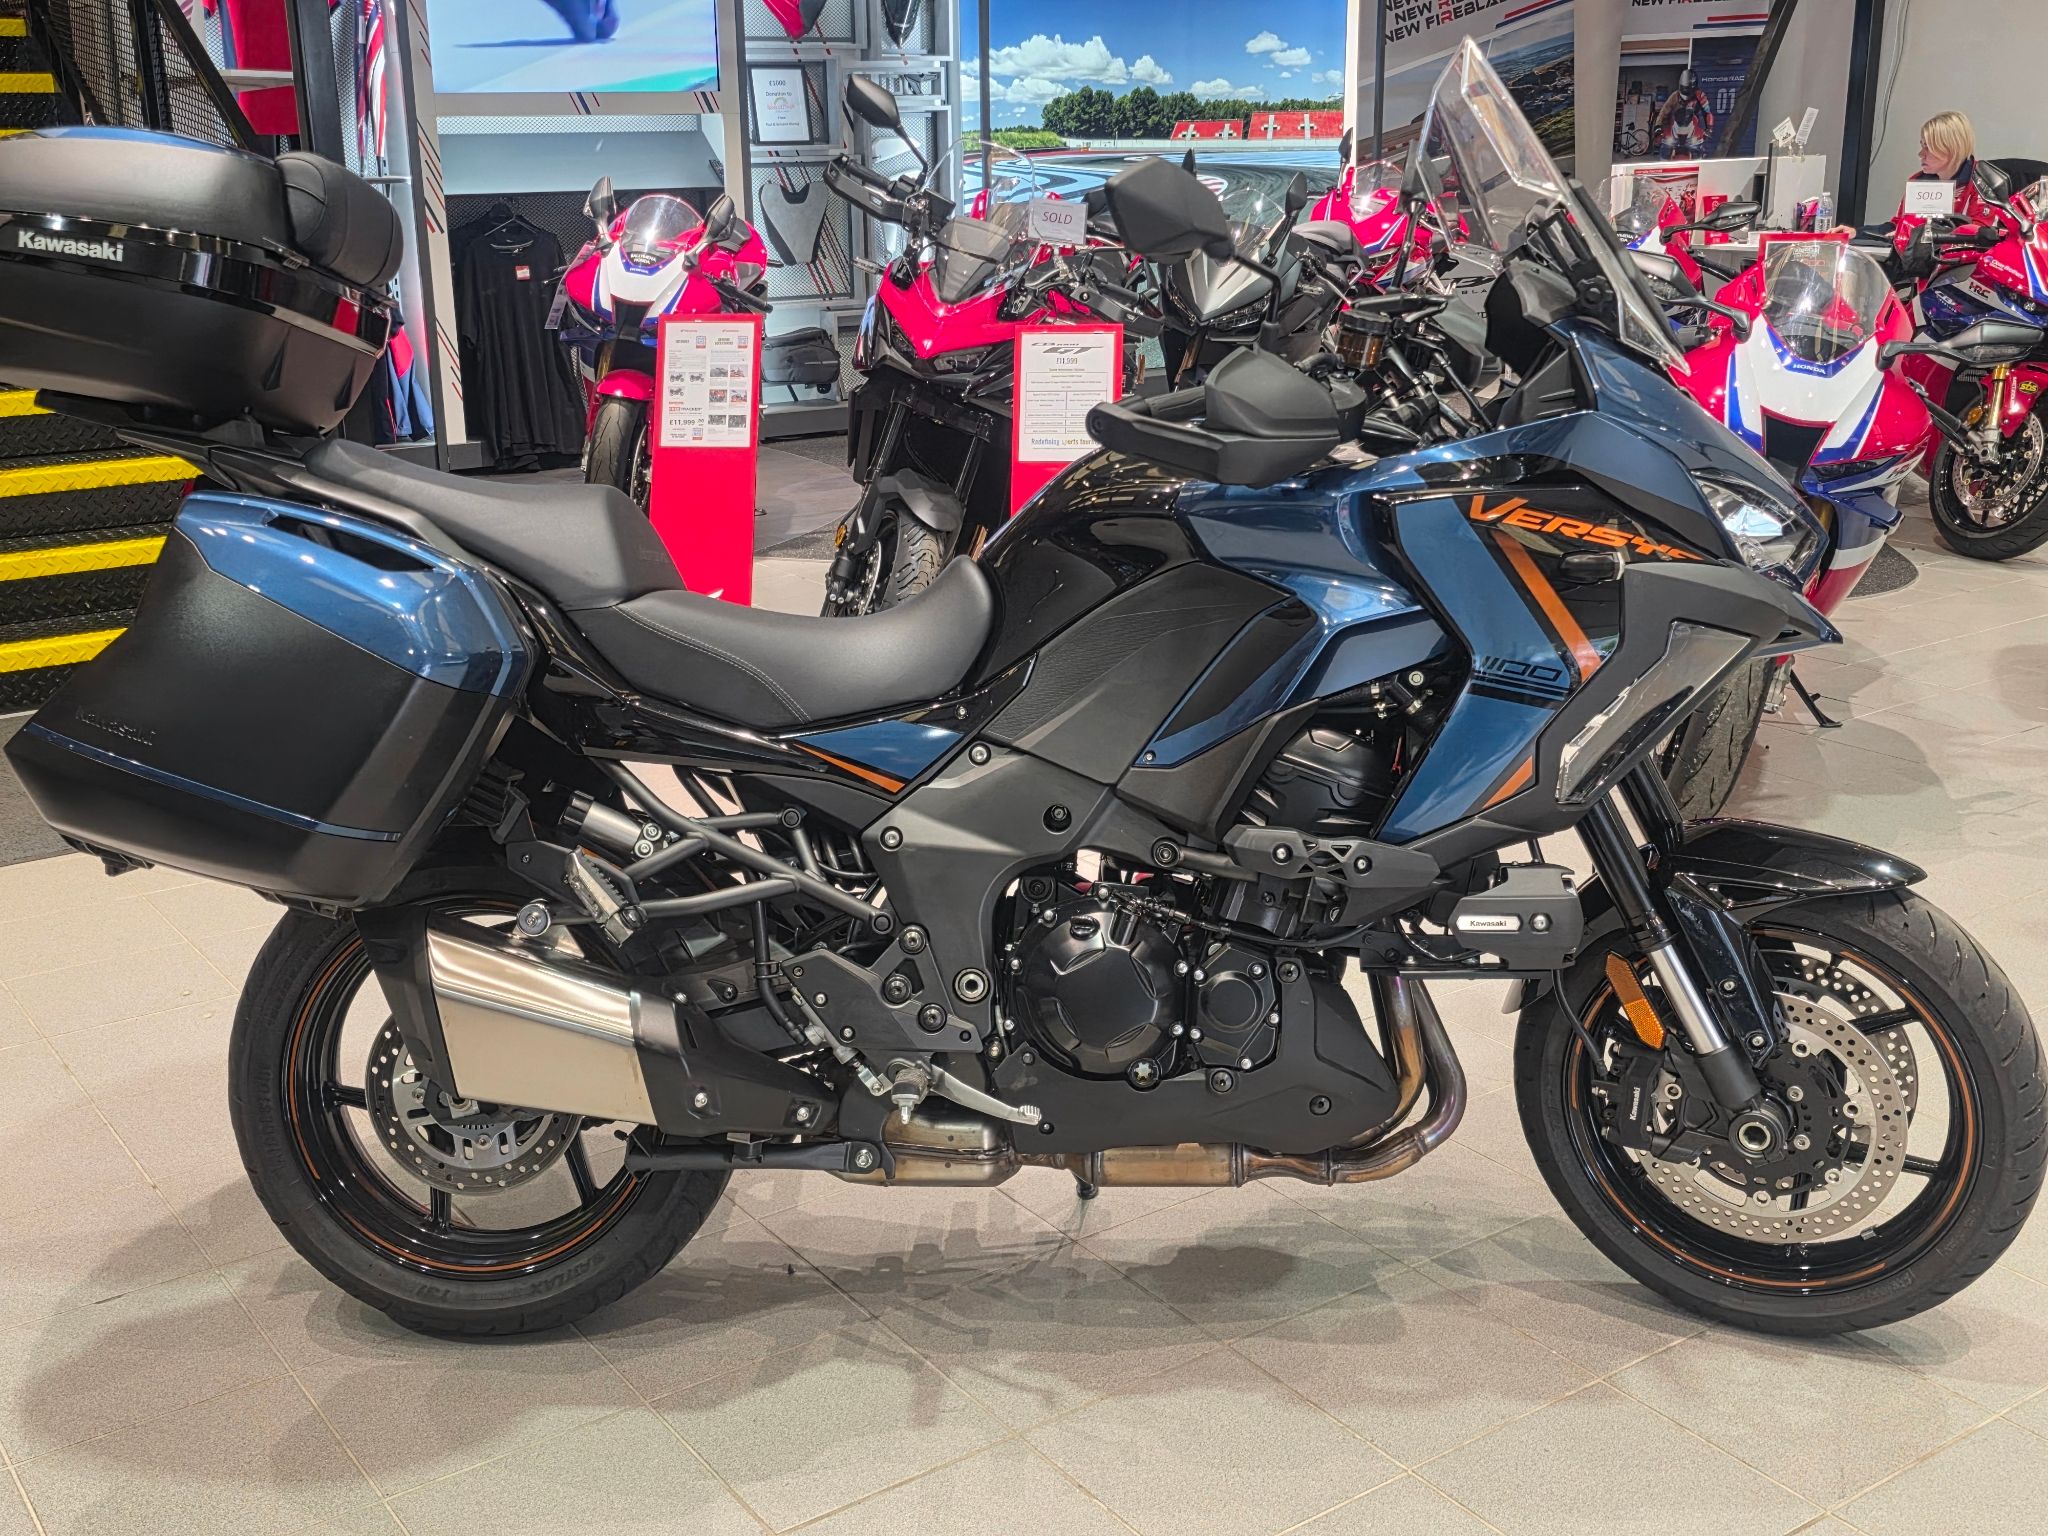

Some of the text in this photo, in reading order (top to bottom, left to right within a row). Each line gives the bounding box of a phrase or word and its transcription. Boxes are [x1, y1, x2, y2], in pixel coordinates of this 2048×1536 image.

[1395, 1, 1432, 25] NEW
[1425, 0, 1507, 29] FIREBLA
[1916, 192, 1943, 200] SOLD
[1042, 211, 1073, 225] SOLD
[18, 230, 124, 262] Kawasaki
[1792, 363, 1826, 375] HONDA
[1629, 1086, 1641, 1121] Kawasaki
